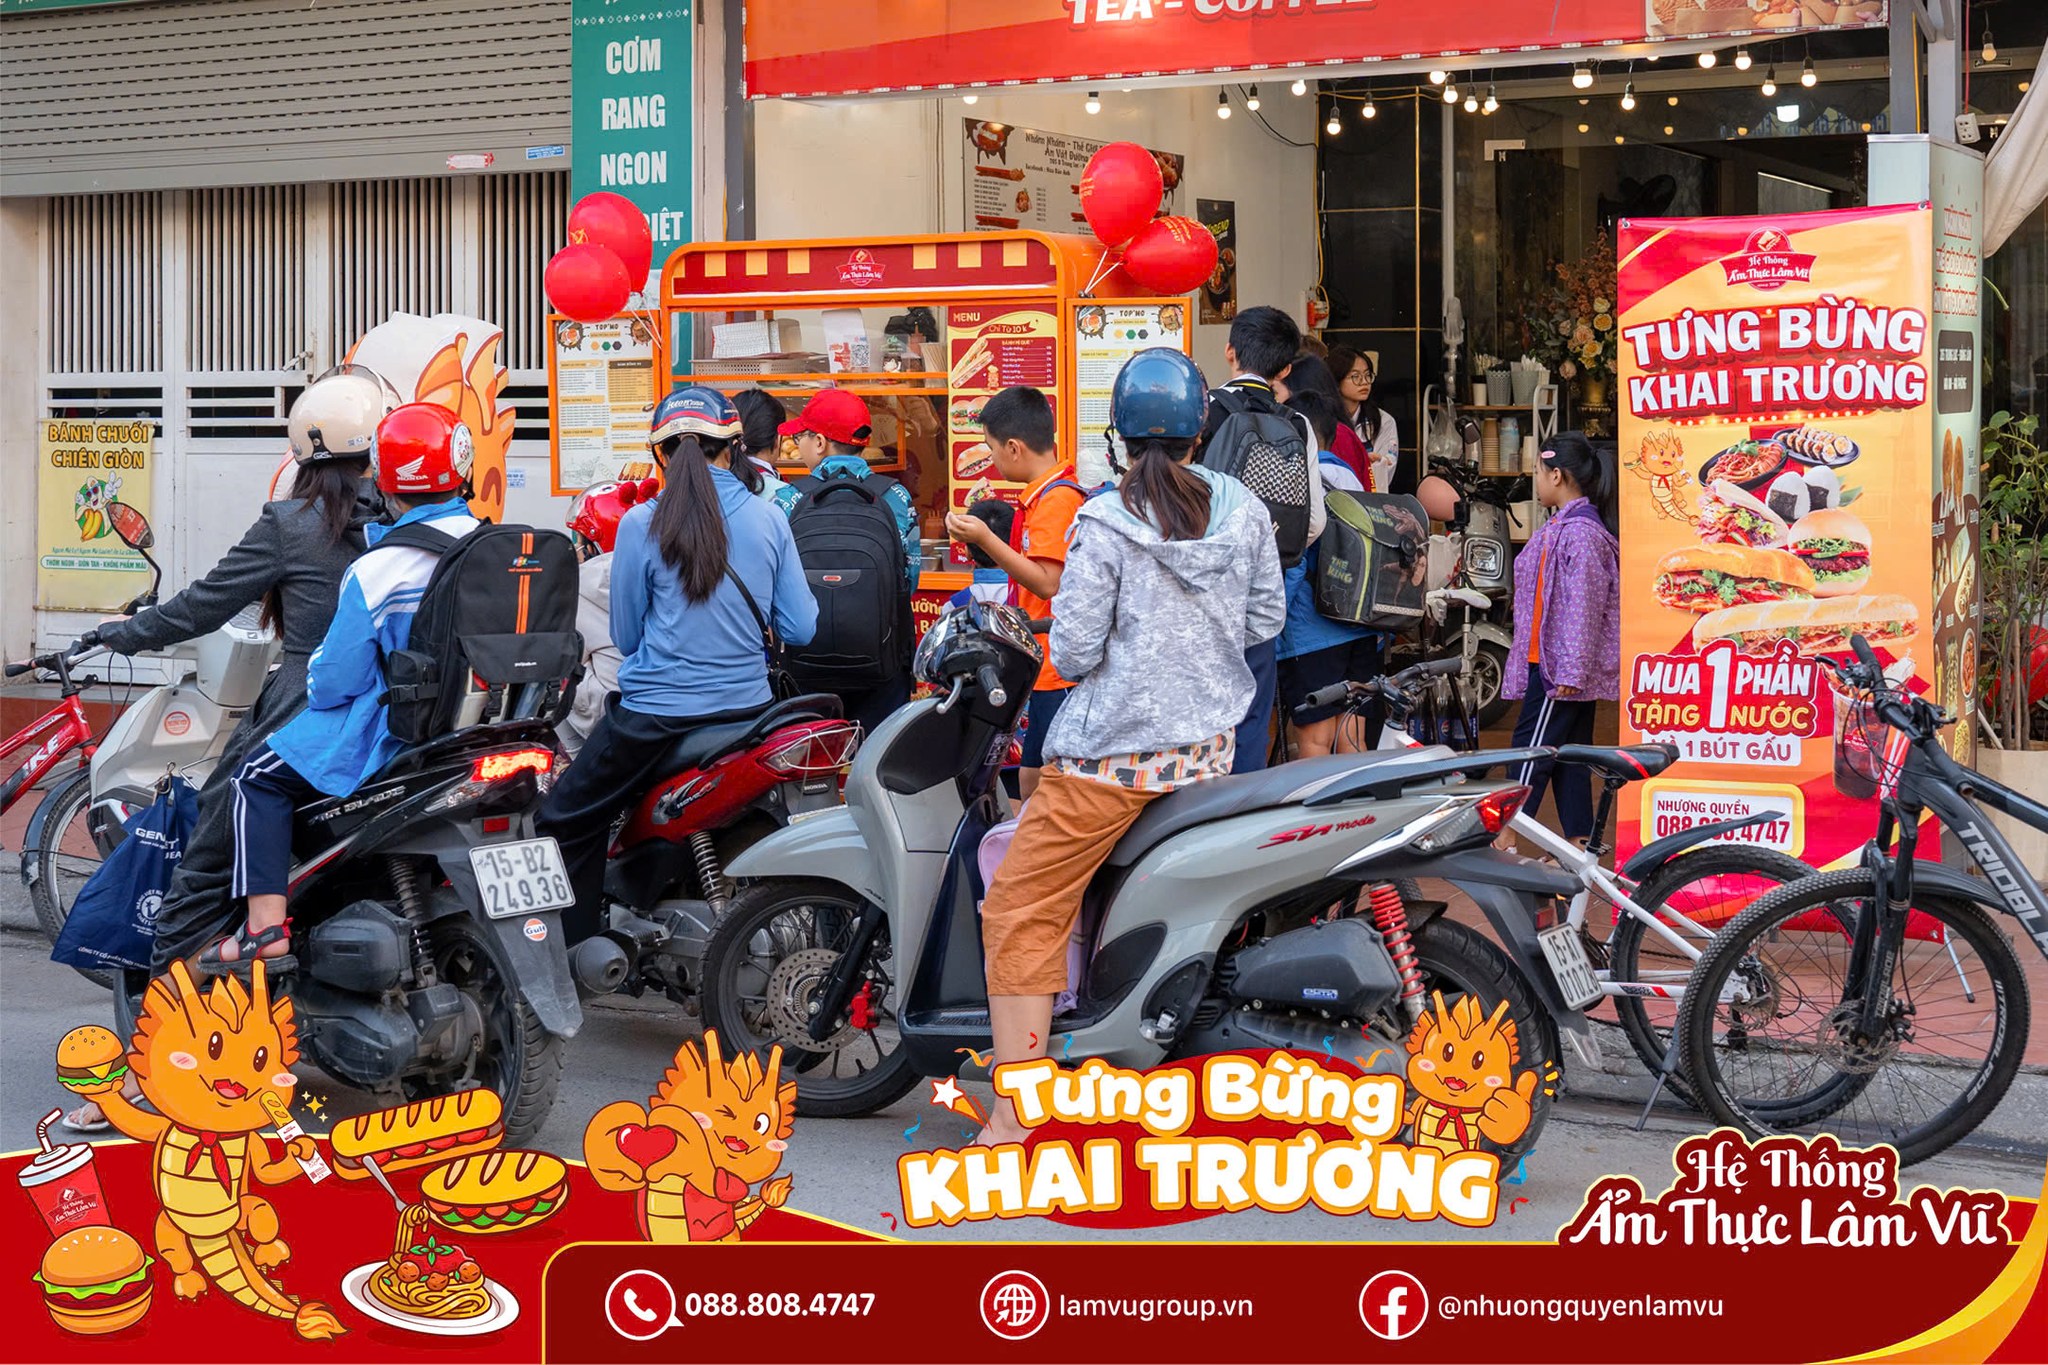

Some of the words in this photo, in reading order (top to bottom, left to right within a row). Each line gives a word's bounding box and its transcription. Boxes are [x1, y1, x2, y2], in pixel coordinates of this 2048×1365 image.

[605, 36, 661, 75] CƠM
[602, 94, 666, 130] RANG
[600, 151, 667, 186] NGON
[645, 207, 684, 247] IỆT
[1771, 267, 1795, 278] Lâm
[953, 312, 981, 322] MENU
[1012, 325, 1022, 333] 10
[1625, 310, 1760, 366] TƯNG
[1779, 296, 1925, 354] BỪNG
[1630, 370, 1729, 413] KHAI
[1743, 358, 1925, 402] TRƯƠNG
[48, 422, 93, 443] BÁNH
[97, 421, 149, 443] CHUỐI
[51, 447, 99, 469] CHIÊN
[102, 448, 144, 469] GIÒN
[1638, 661, 1700, 695] MUA
[1706, 647, 1732, 729] 1
[1734, 646, 1811, 696] PHẦN
[1632, 699, 1700, 728] TẶNG
[1729, 700, 1810, 729] NƯỚC
[1685, 740, 1693, 757] 1
[1700, 736, 1740, 759] BÚT
[1745, 736, 1791, 762] GẤU
[804, 782, 829, 791] HONDA
[1657, 799, 1706, 813] NHƯỢNG
[1709, 800, 1750, 816] QUYỀN
[1335, 814, 1377, 832] mode
[486, 844, 551, 879] 15-B2
[487, 873, 568, 913] 249.36
[525, 925, 546, 935] Gulf
